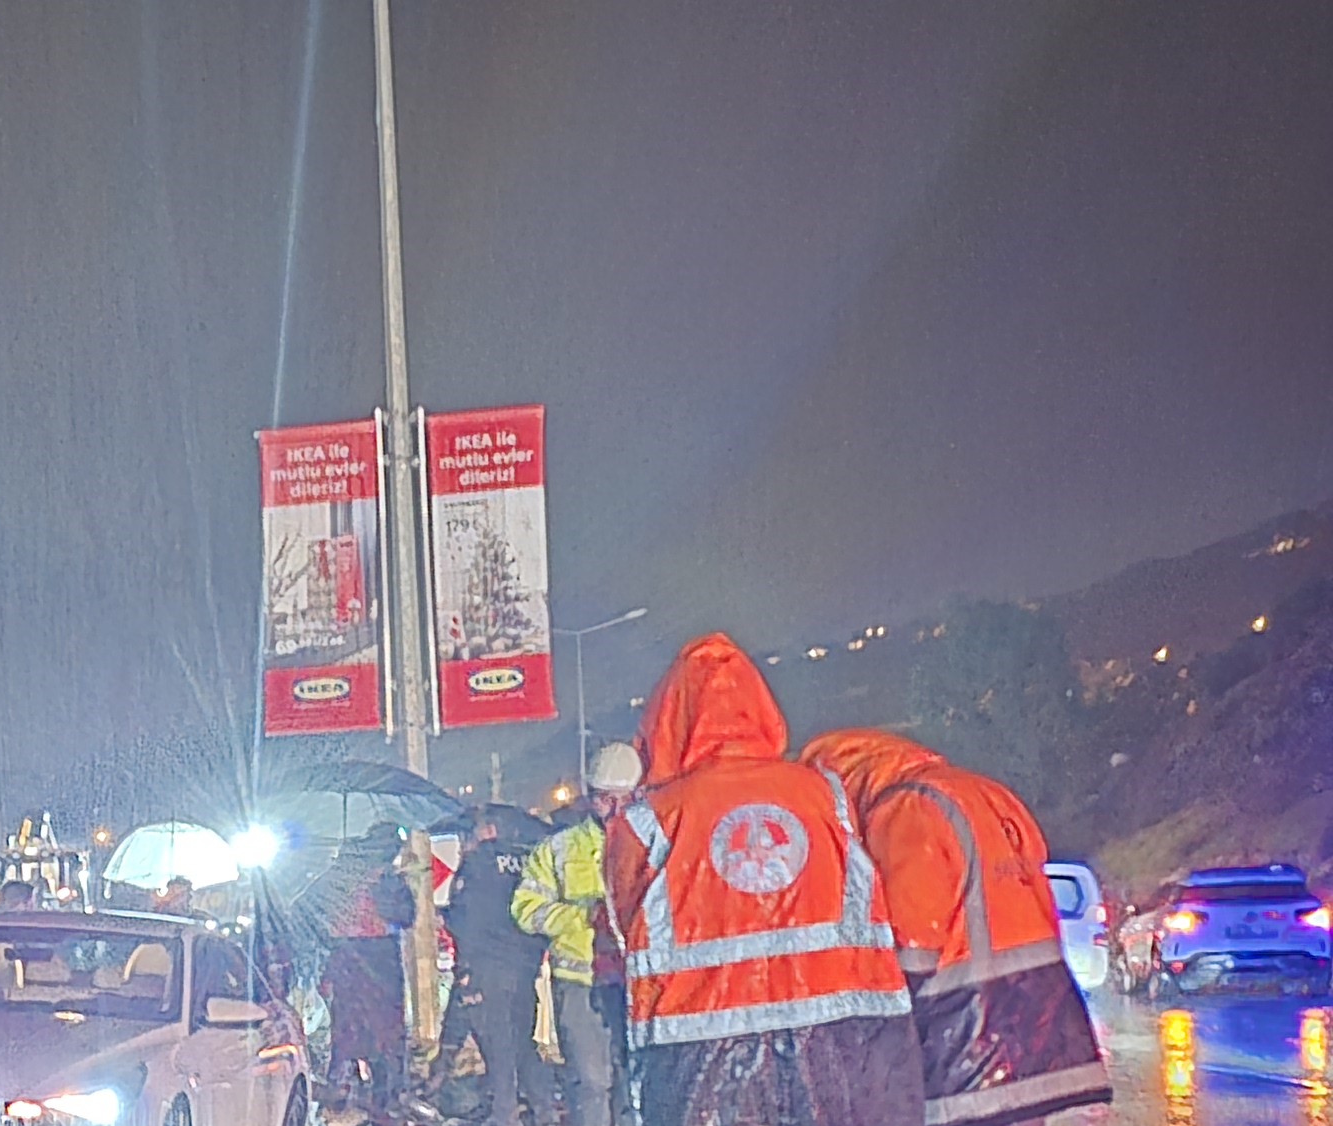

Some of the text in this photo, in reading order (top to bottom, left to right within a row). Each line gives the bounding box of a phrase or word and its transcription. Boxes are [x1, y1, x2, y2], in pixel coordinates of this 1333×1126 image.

[455, 430, 517, 451] IKEA ile
[286, 442, 350, 462] IKEA ile
[439, 448, 534, 470] mutlu evler
[270, 460, 367, 482] mutlu evler
